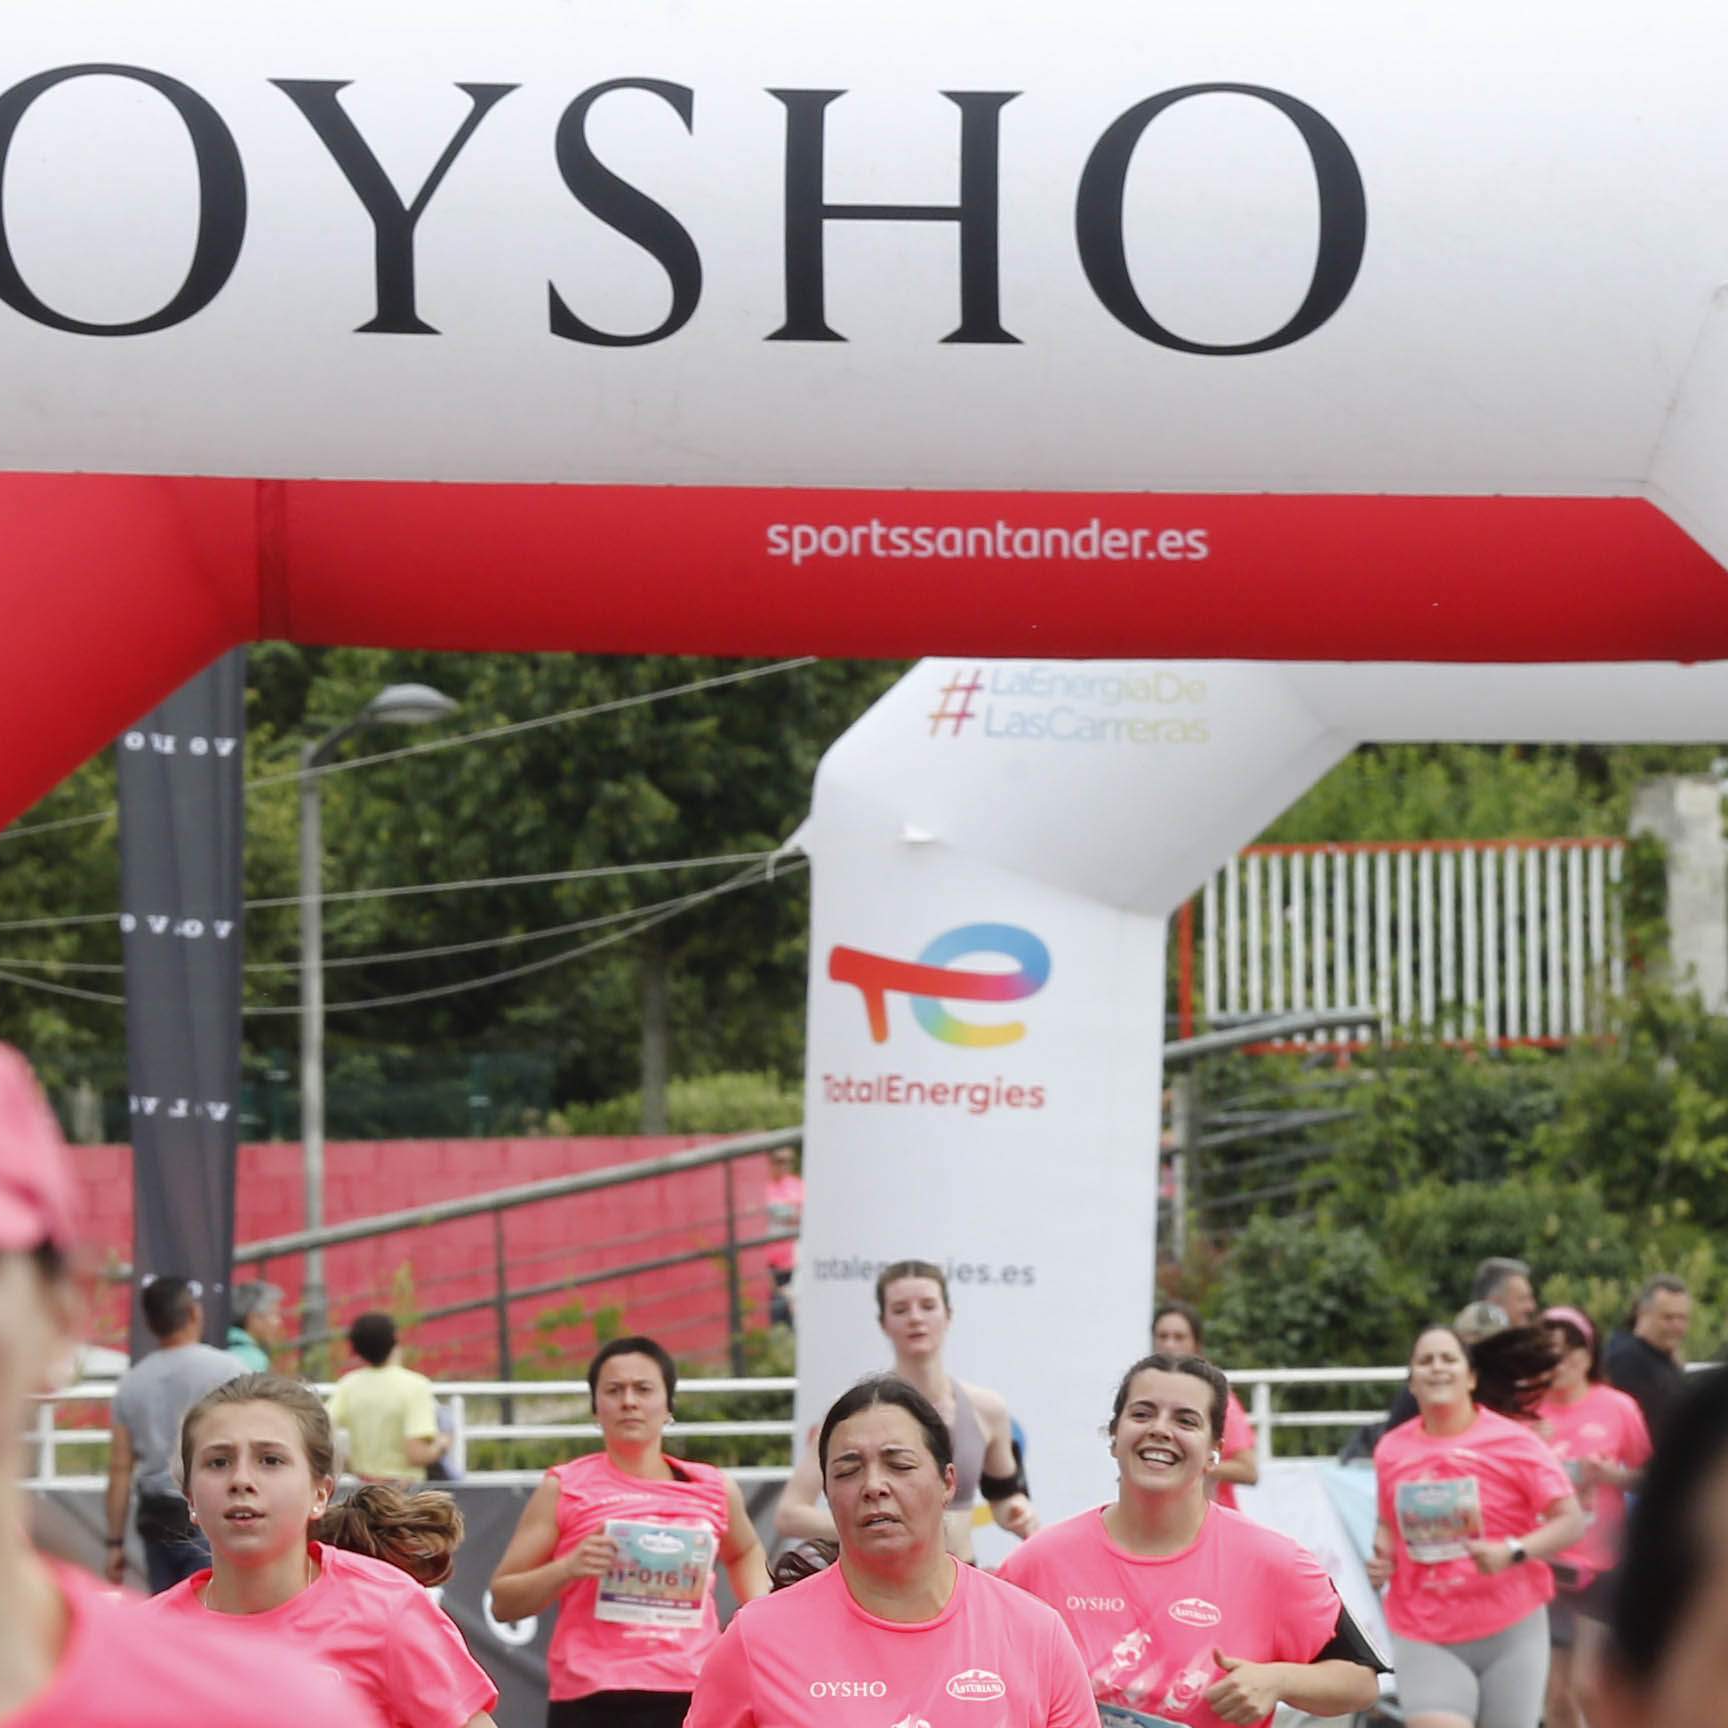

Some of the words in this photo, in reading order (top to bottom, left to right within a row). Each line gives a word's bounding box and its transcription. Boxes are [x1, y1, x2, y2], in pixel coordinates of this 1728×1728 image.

[767, 517, 1210, 566] sportssantander.es
[821, 1073, 1047, 1115] TotalEnergies
[639, 1567, 679, 1587] 016
[1067, 1595, 1125, 1612] OYSHO
[809, 1680, 888, 1698] OYSHO
